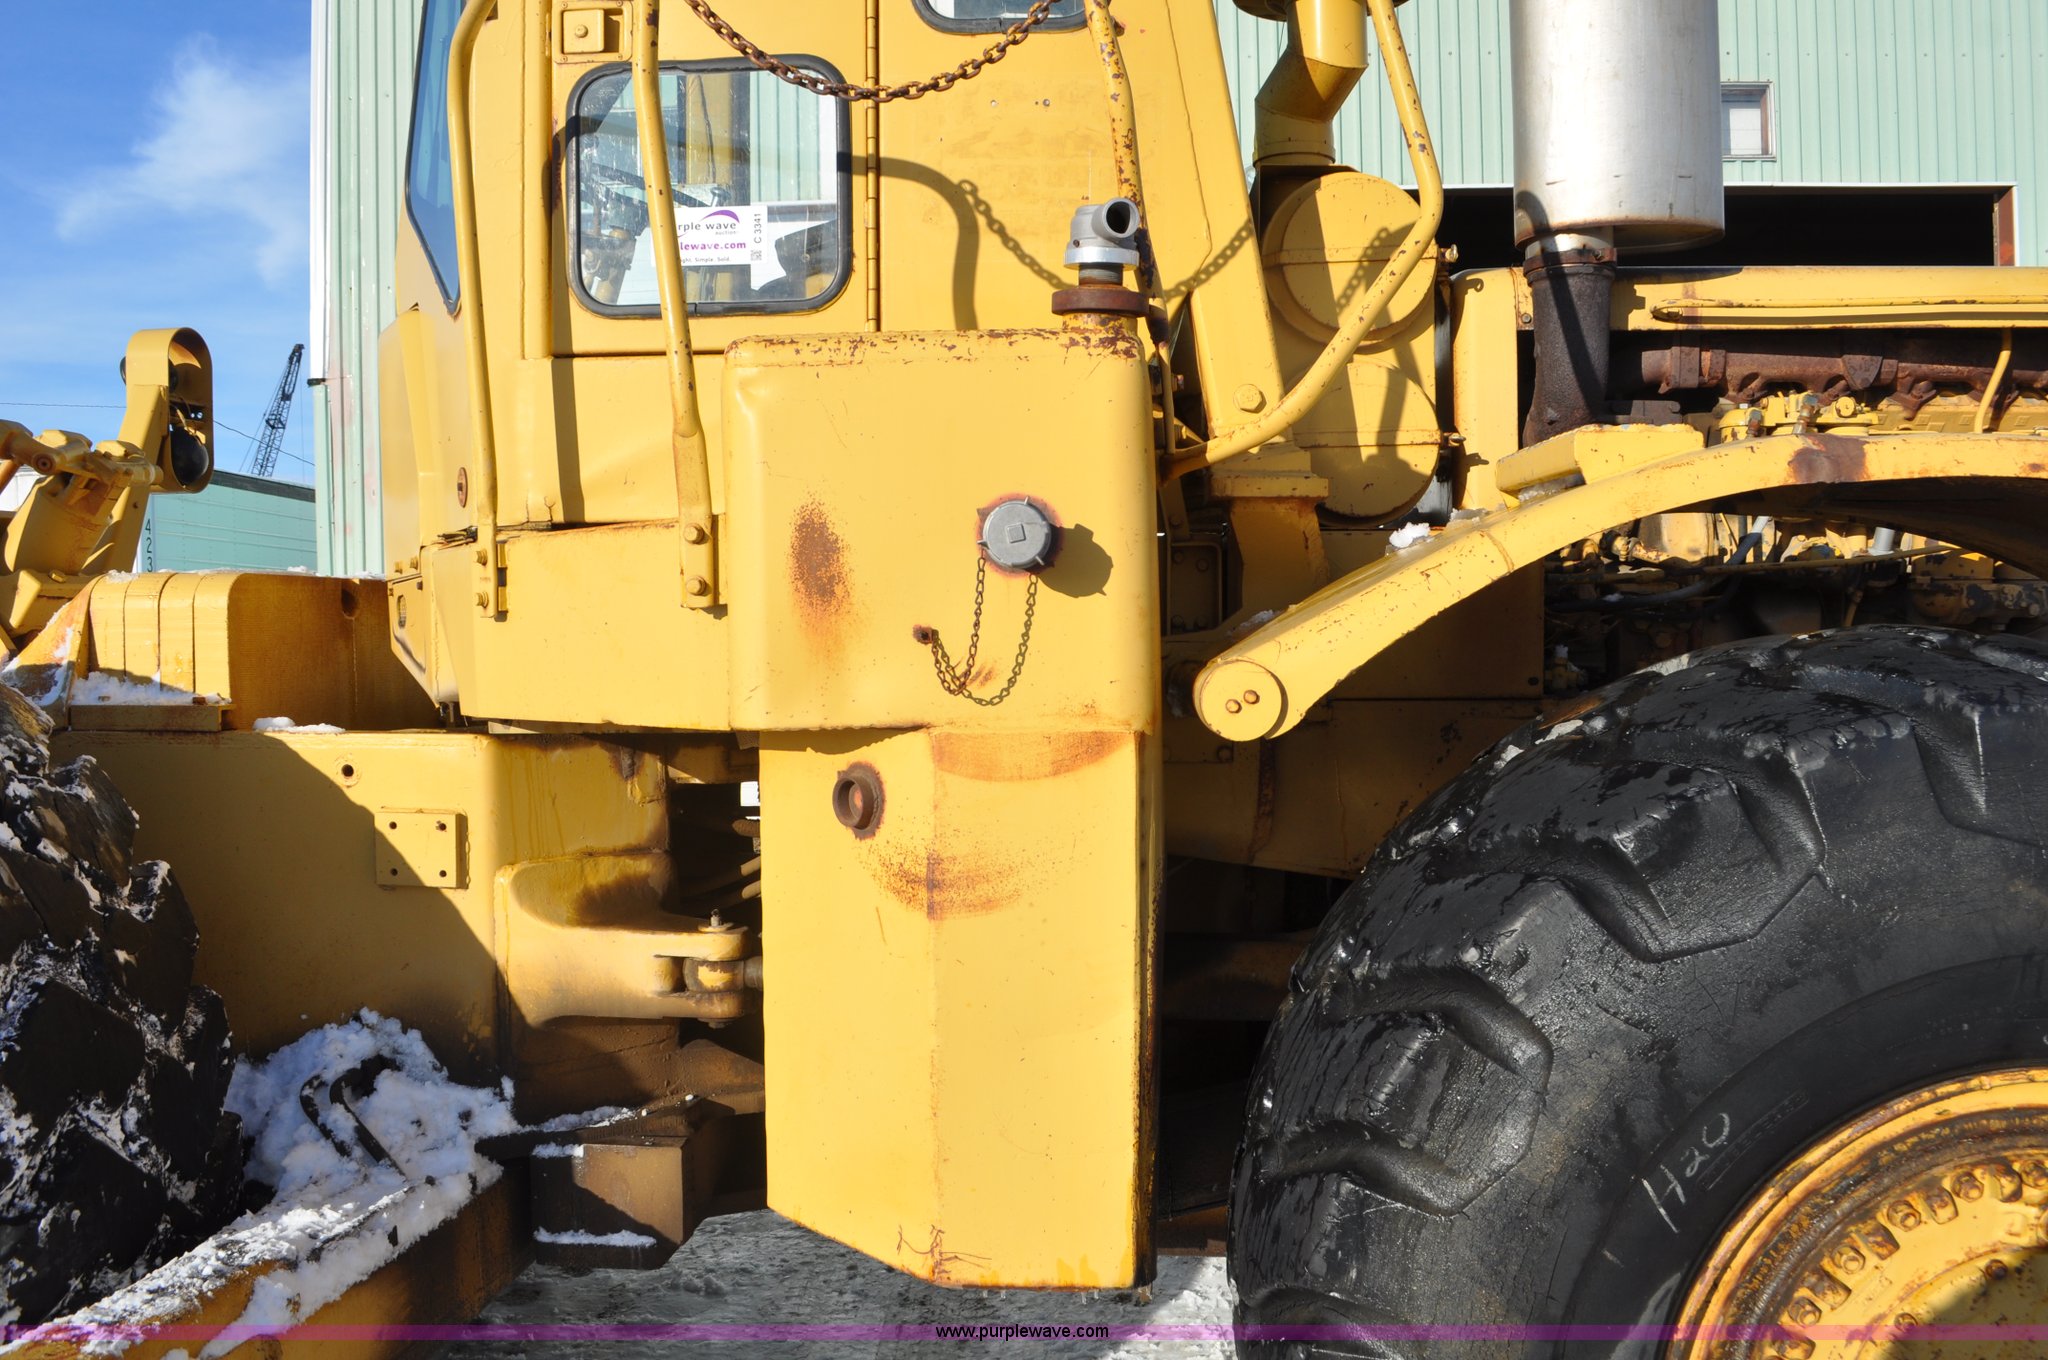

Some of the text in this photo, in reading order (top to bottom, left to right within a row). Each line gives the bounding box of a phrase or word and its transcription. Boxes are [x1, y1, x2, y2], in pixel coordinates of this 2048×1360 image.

[678, 222, 737, 232] rple wave
[753, 213, 762, 244] C 3341
[680, 241, 747, 250] lewave.com
